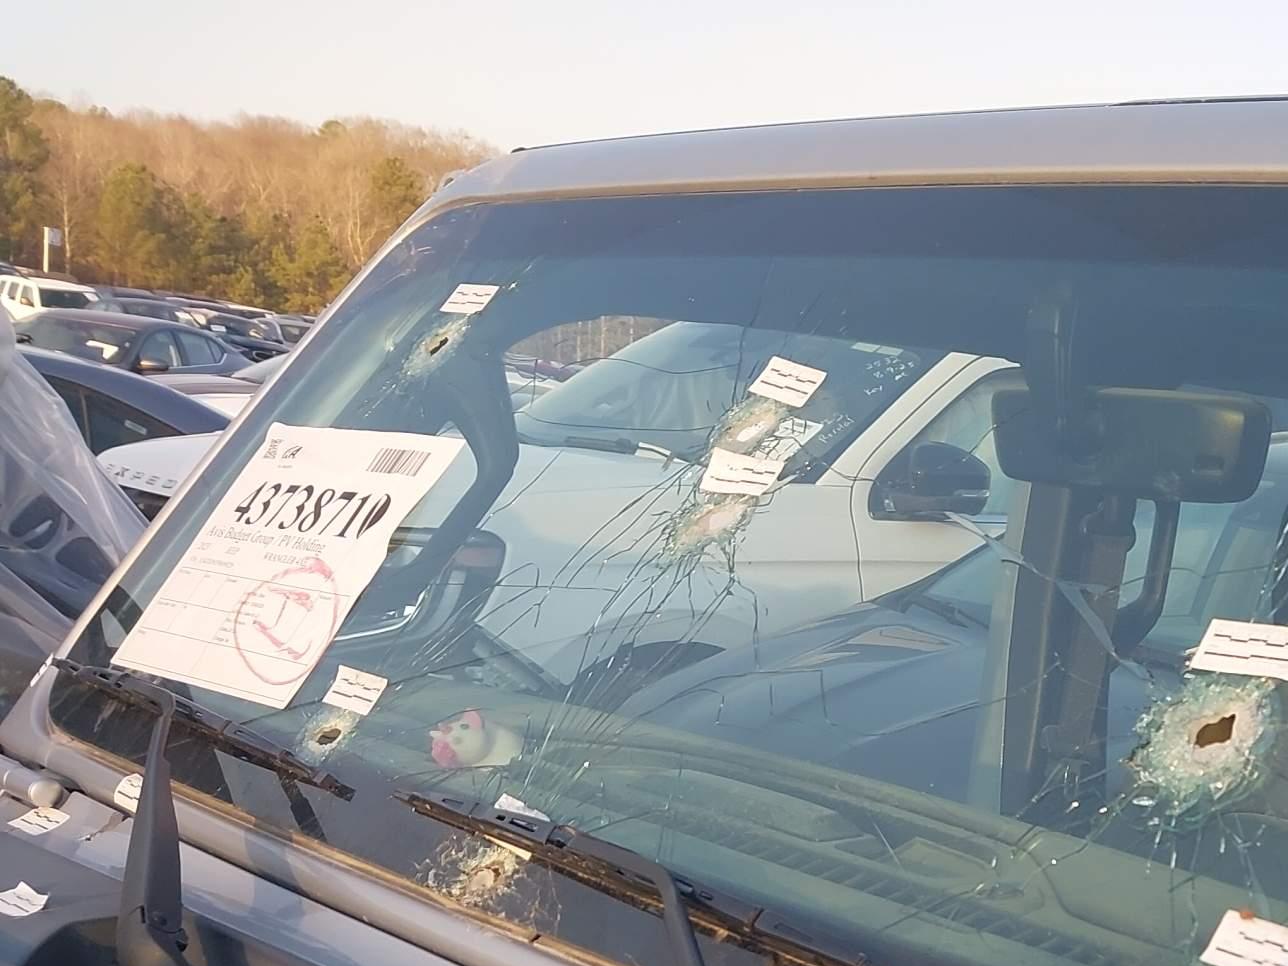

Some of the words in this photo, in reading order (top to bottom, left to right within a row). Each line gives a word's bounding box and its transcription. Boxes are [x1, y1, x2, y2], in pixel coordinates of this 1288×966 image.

[234, 481, 391, 539] 43738710
[208, 526, 223, 538] Avis
[224, 527, 250, 543] Budget
[251, 530, 274, 548] Group
[278, 534, 294, 548] PV
[291, 535, 326, 556] Holding
